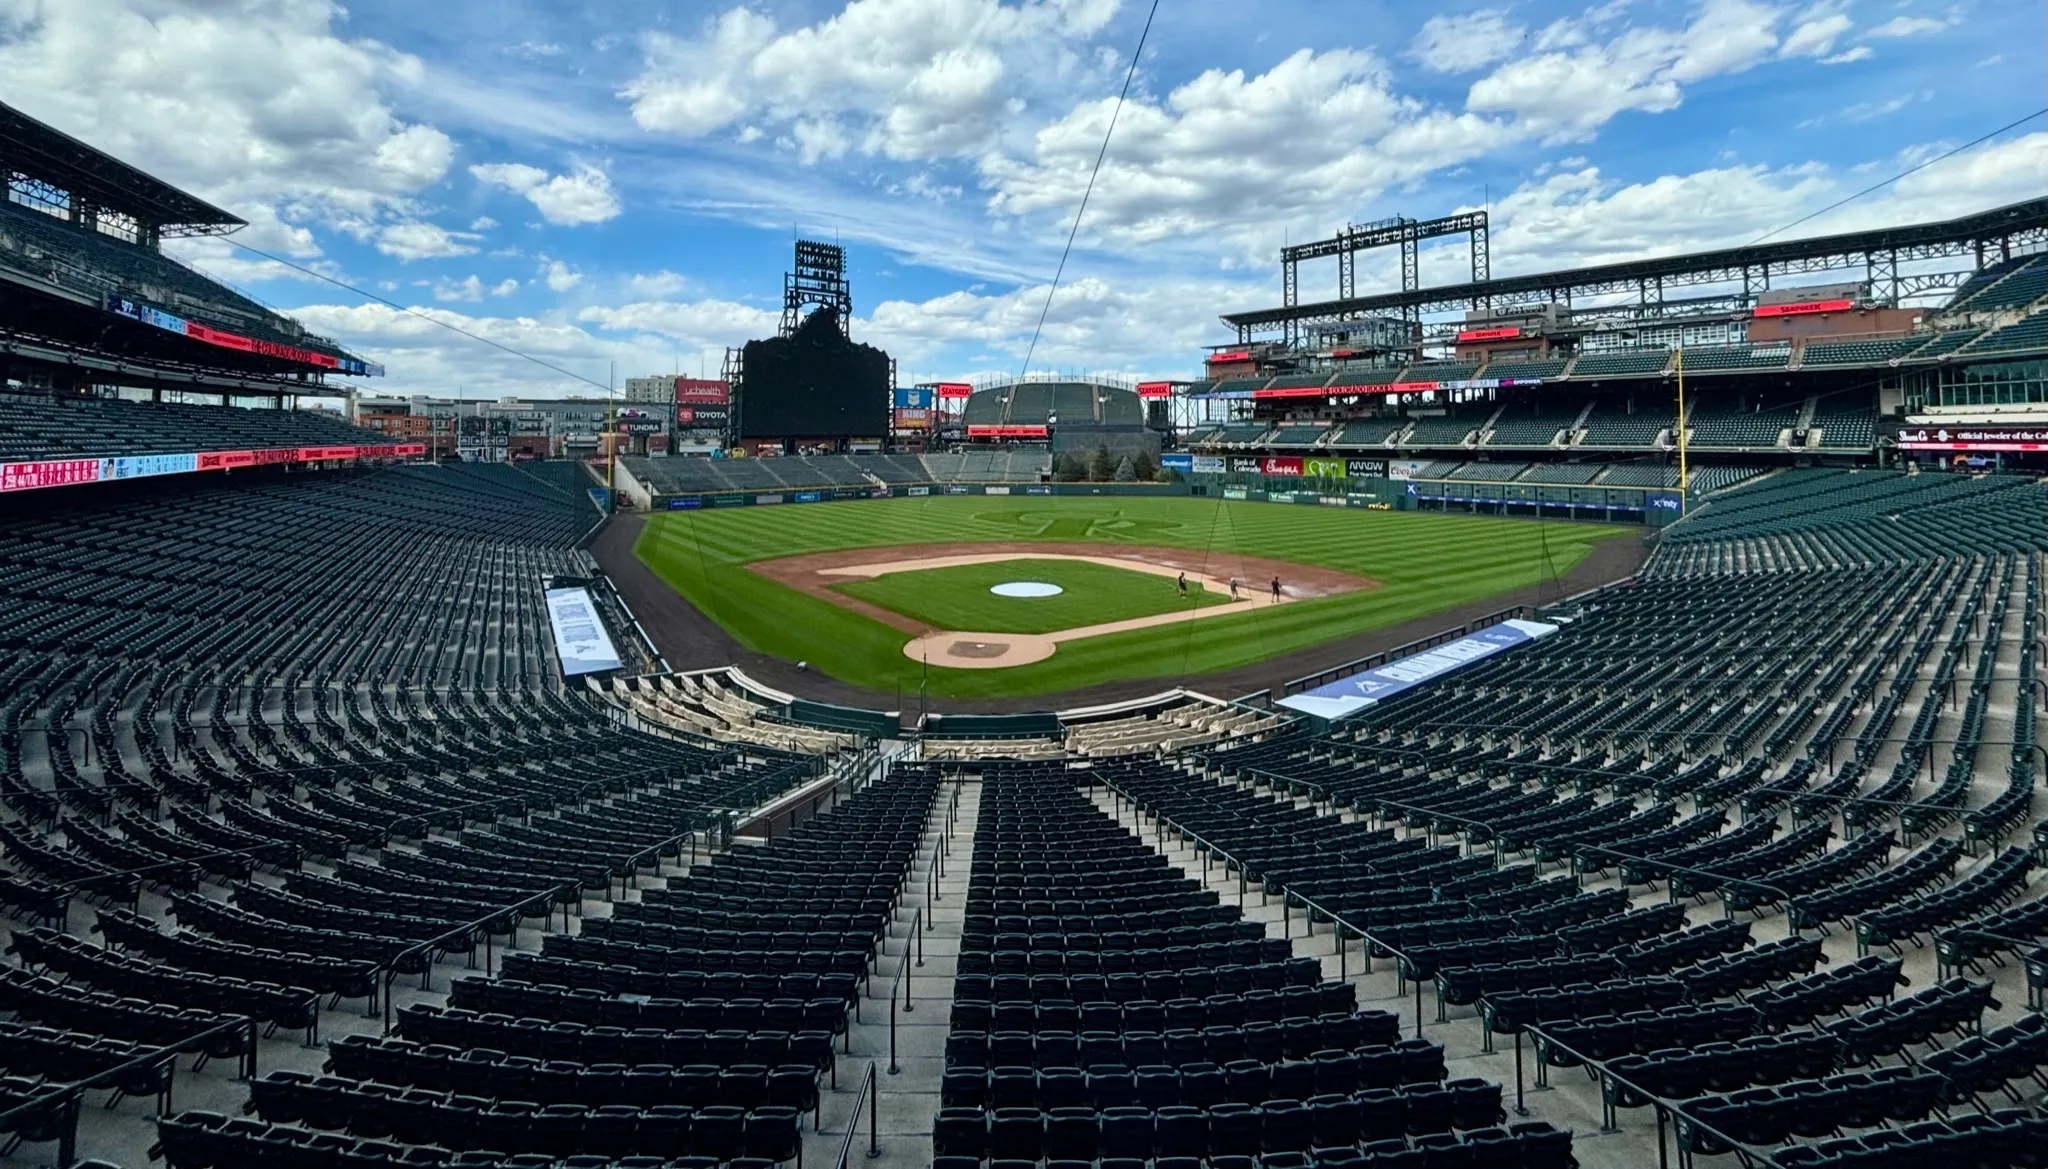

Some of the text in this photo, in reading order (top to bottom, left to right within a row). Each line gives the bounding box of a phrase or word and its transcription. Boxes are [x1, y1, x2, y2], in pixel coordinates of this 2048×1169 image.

[685, 385, 721, 395] uchealth
[941, 387, 970, 396] SEATGEEK
[1138, 385, 1167, 395] SEATGEEK
[695, 411, 727, 419] TOYOTA
[1957, 432, 1983, 440] Official
[2011, 432, 2021, 440] of
[2021, 432, 2035, 440] the
[1249, 458, 1256, 466] of
[1349, 461, 1384, 471] ARROW
[1653, 499, 1678, 510] xfinity
